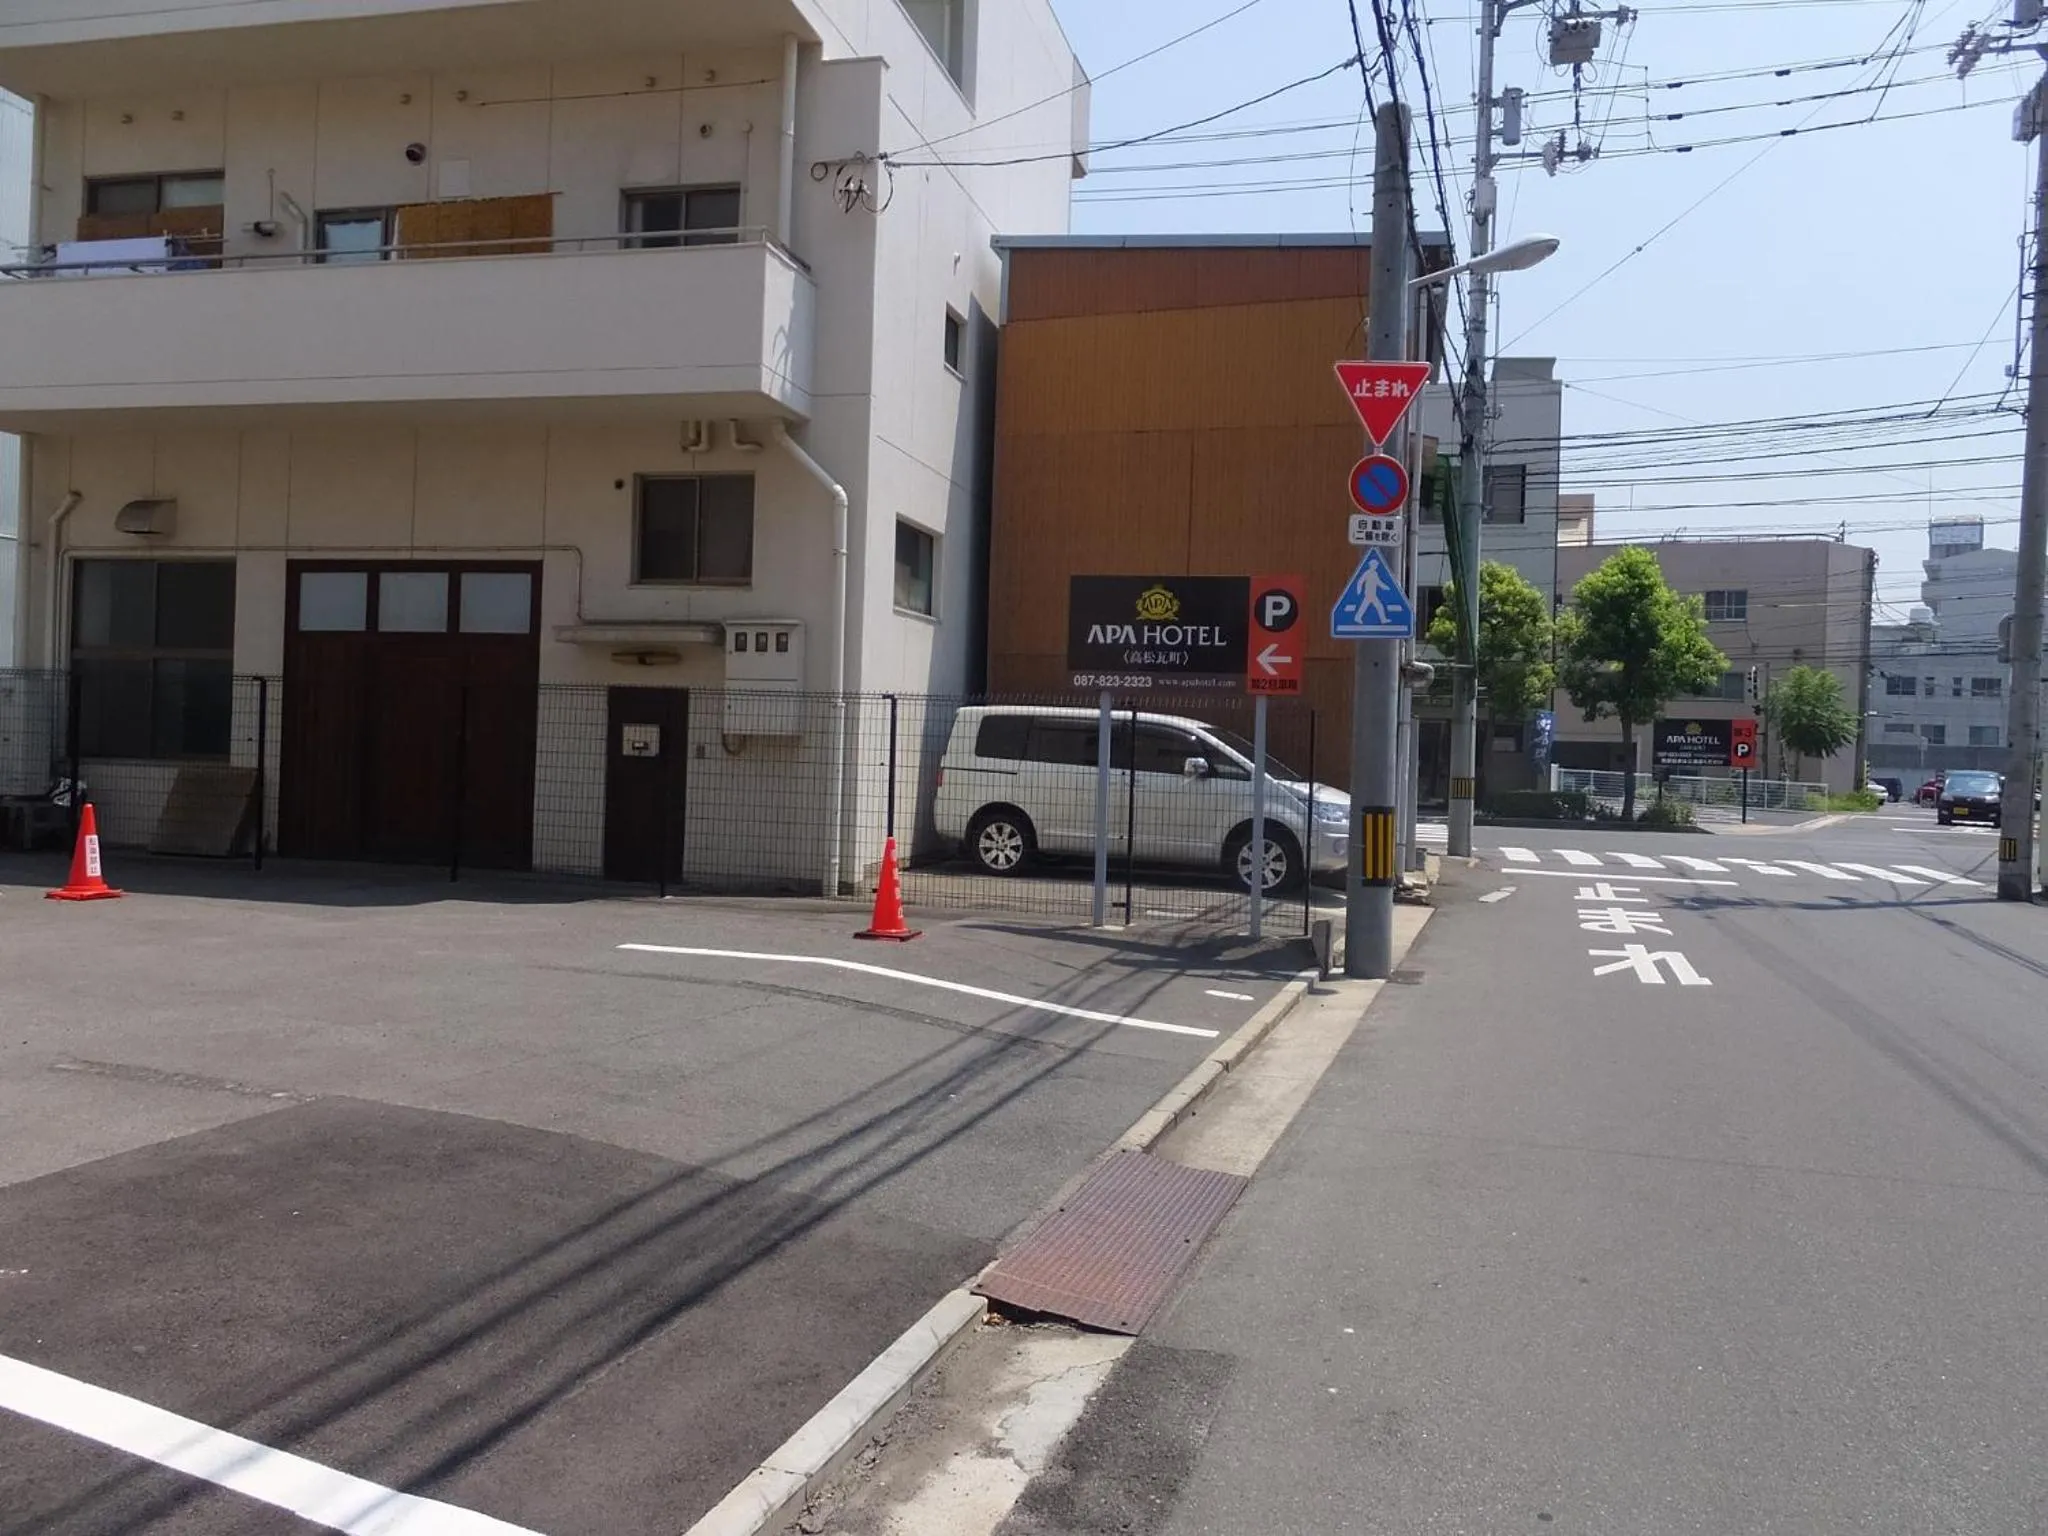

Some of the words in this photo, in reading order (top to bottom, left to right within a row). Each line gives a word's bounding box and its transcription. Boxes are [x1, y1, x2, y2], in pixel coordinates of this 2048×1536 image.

[1354, 380, 1410, 397] 止まれ
[1265, 595, 1291, 626] P
[1087, 625, 1136, 645] APA
[1143, 625, 1227, 646] HOTEL
[1073, 675, 1152, 688] 087-823-2323
[1687, 735, 1721, 745] HOTEL
[1737, 743, 1749, 757] P
[1574, 882, 1713, 985] 止まれ
